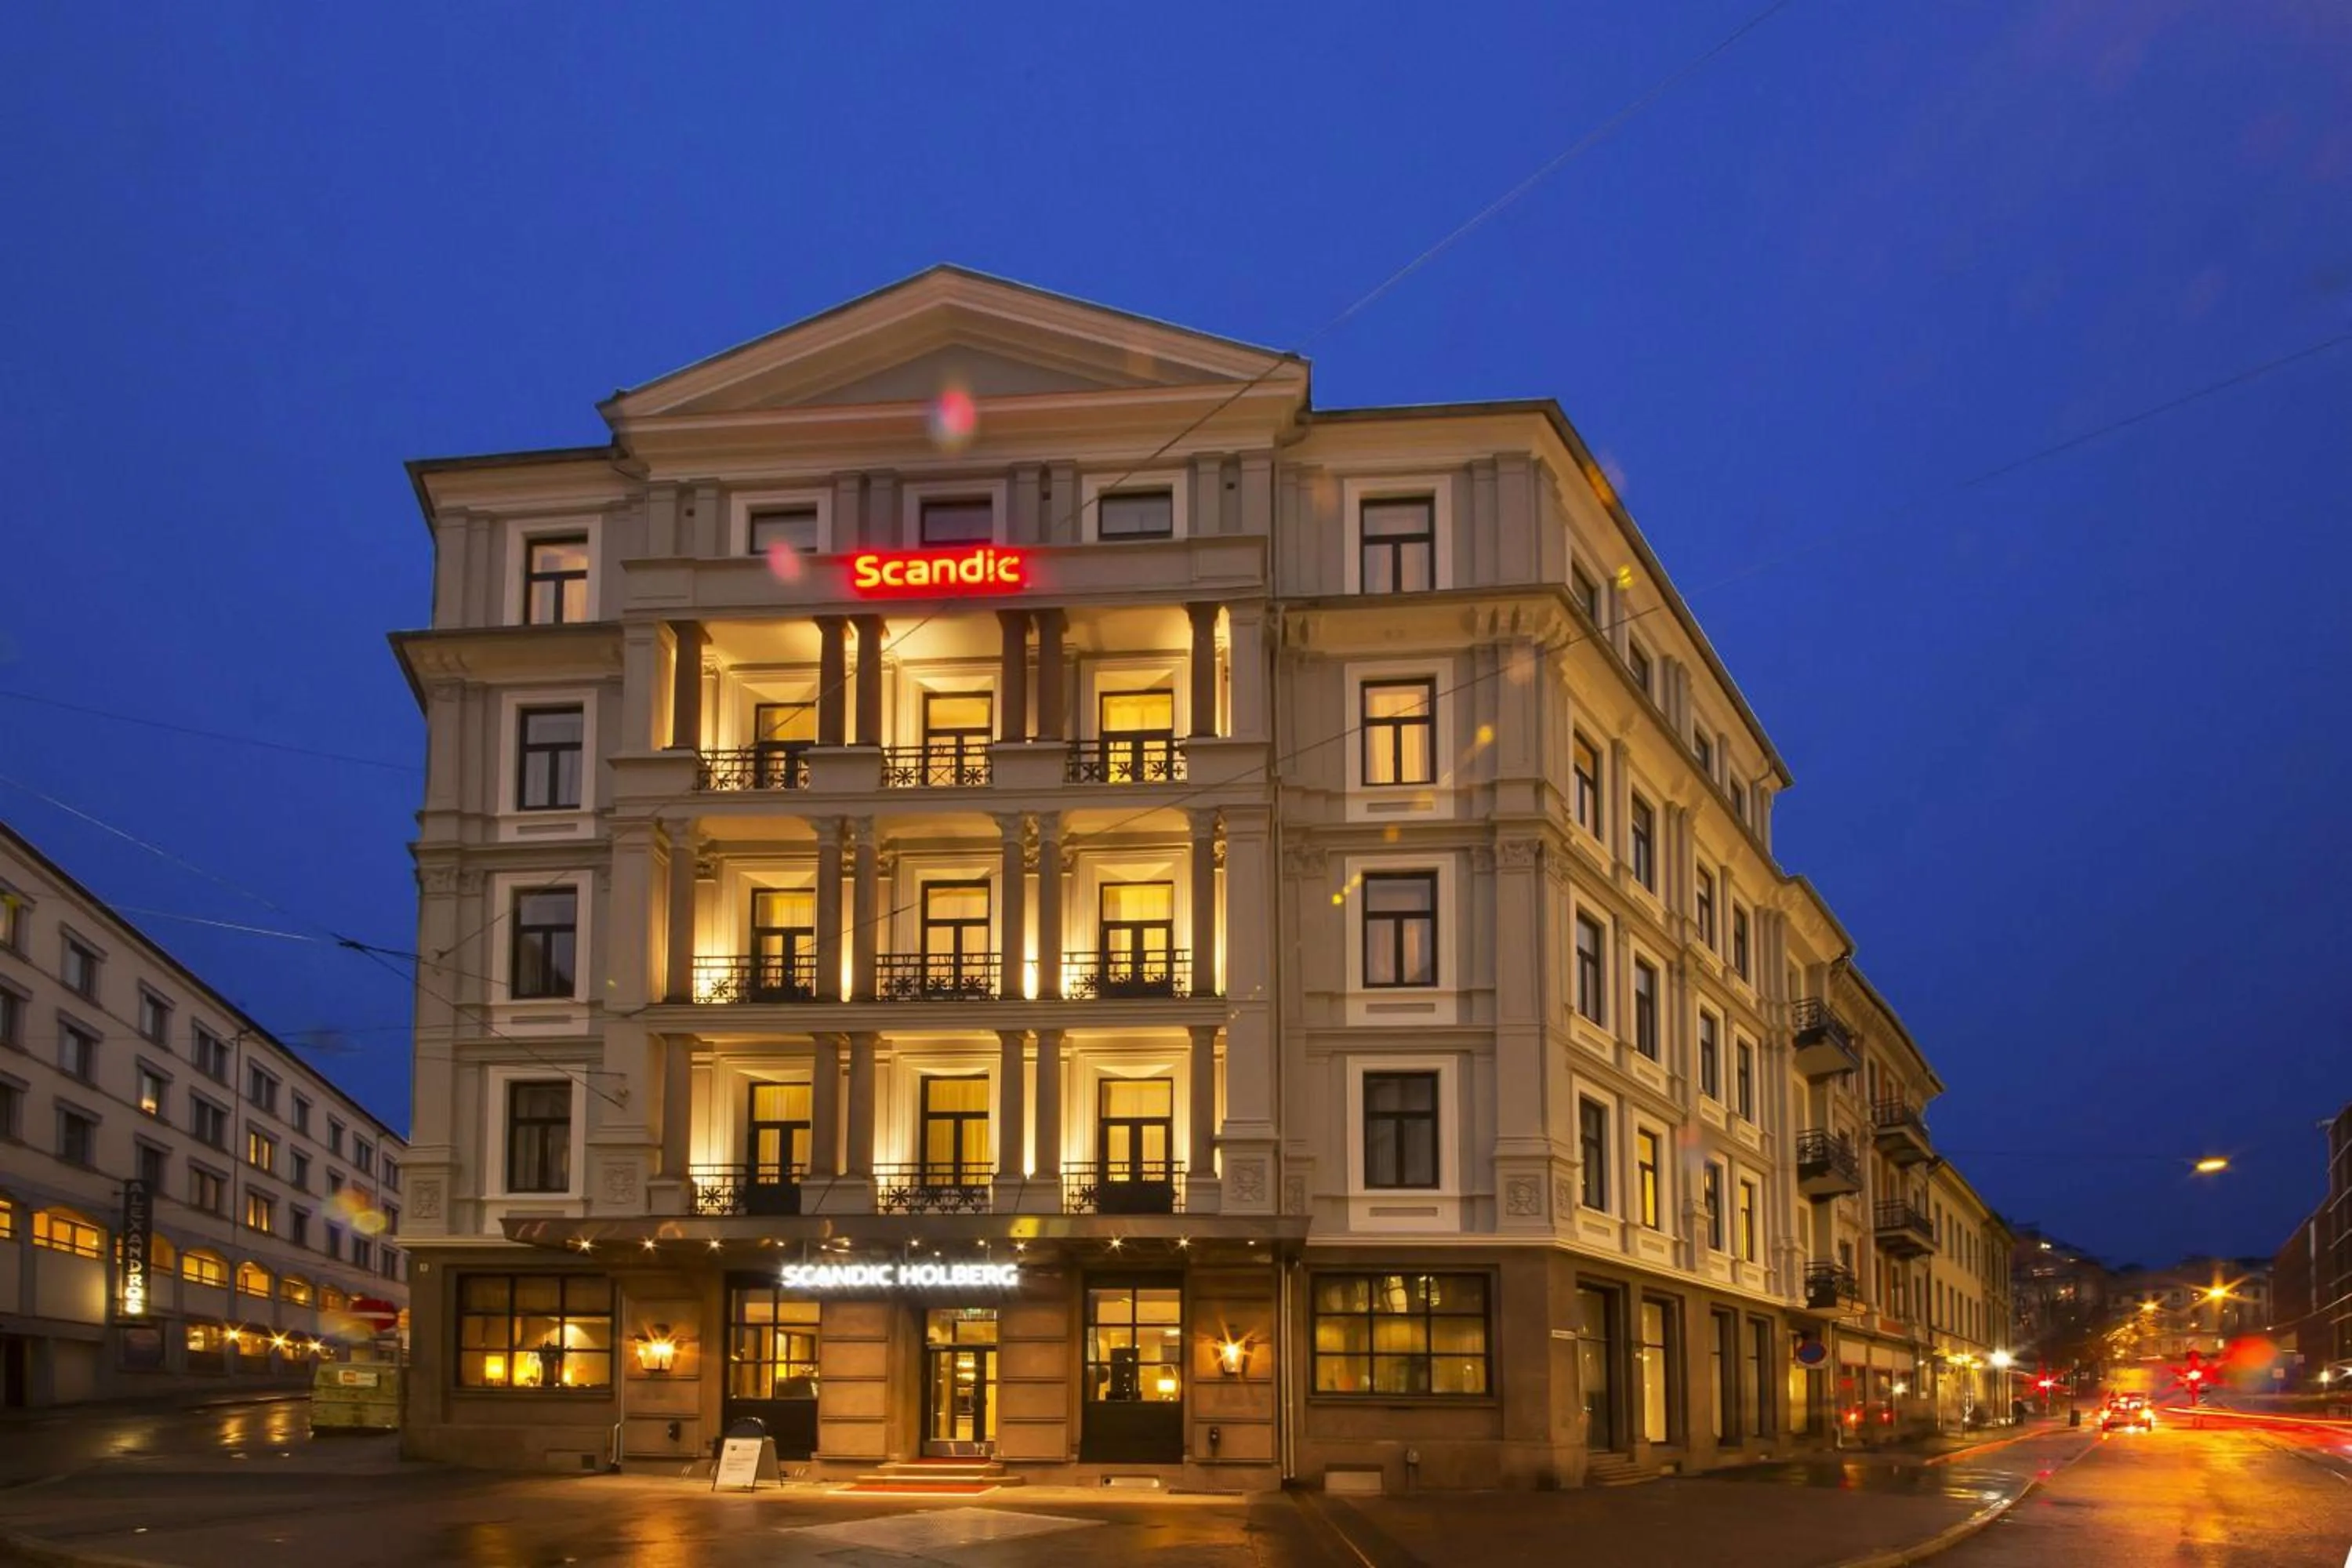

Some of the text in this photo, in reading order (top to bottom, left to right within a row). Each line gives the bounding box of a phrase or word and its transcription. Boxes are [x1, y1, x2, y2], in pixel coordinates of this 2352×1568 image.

[855, 550, 1019, 588] Scandic
[126, 1181, 144, 1316] ALEXANDROS
[782, 1263, 1018, 1287] SCANDIC HOLBERG
